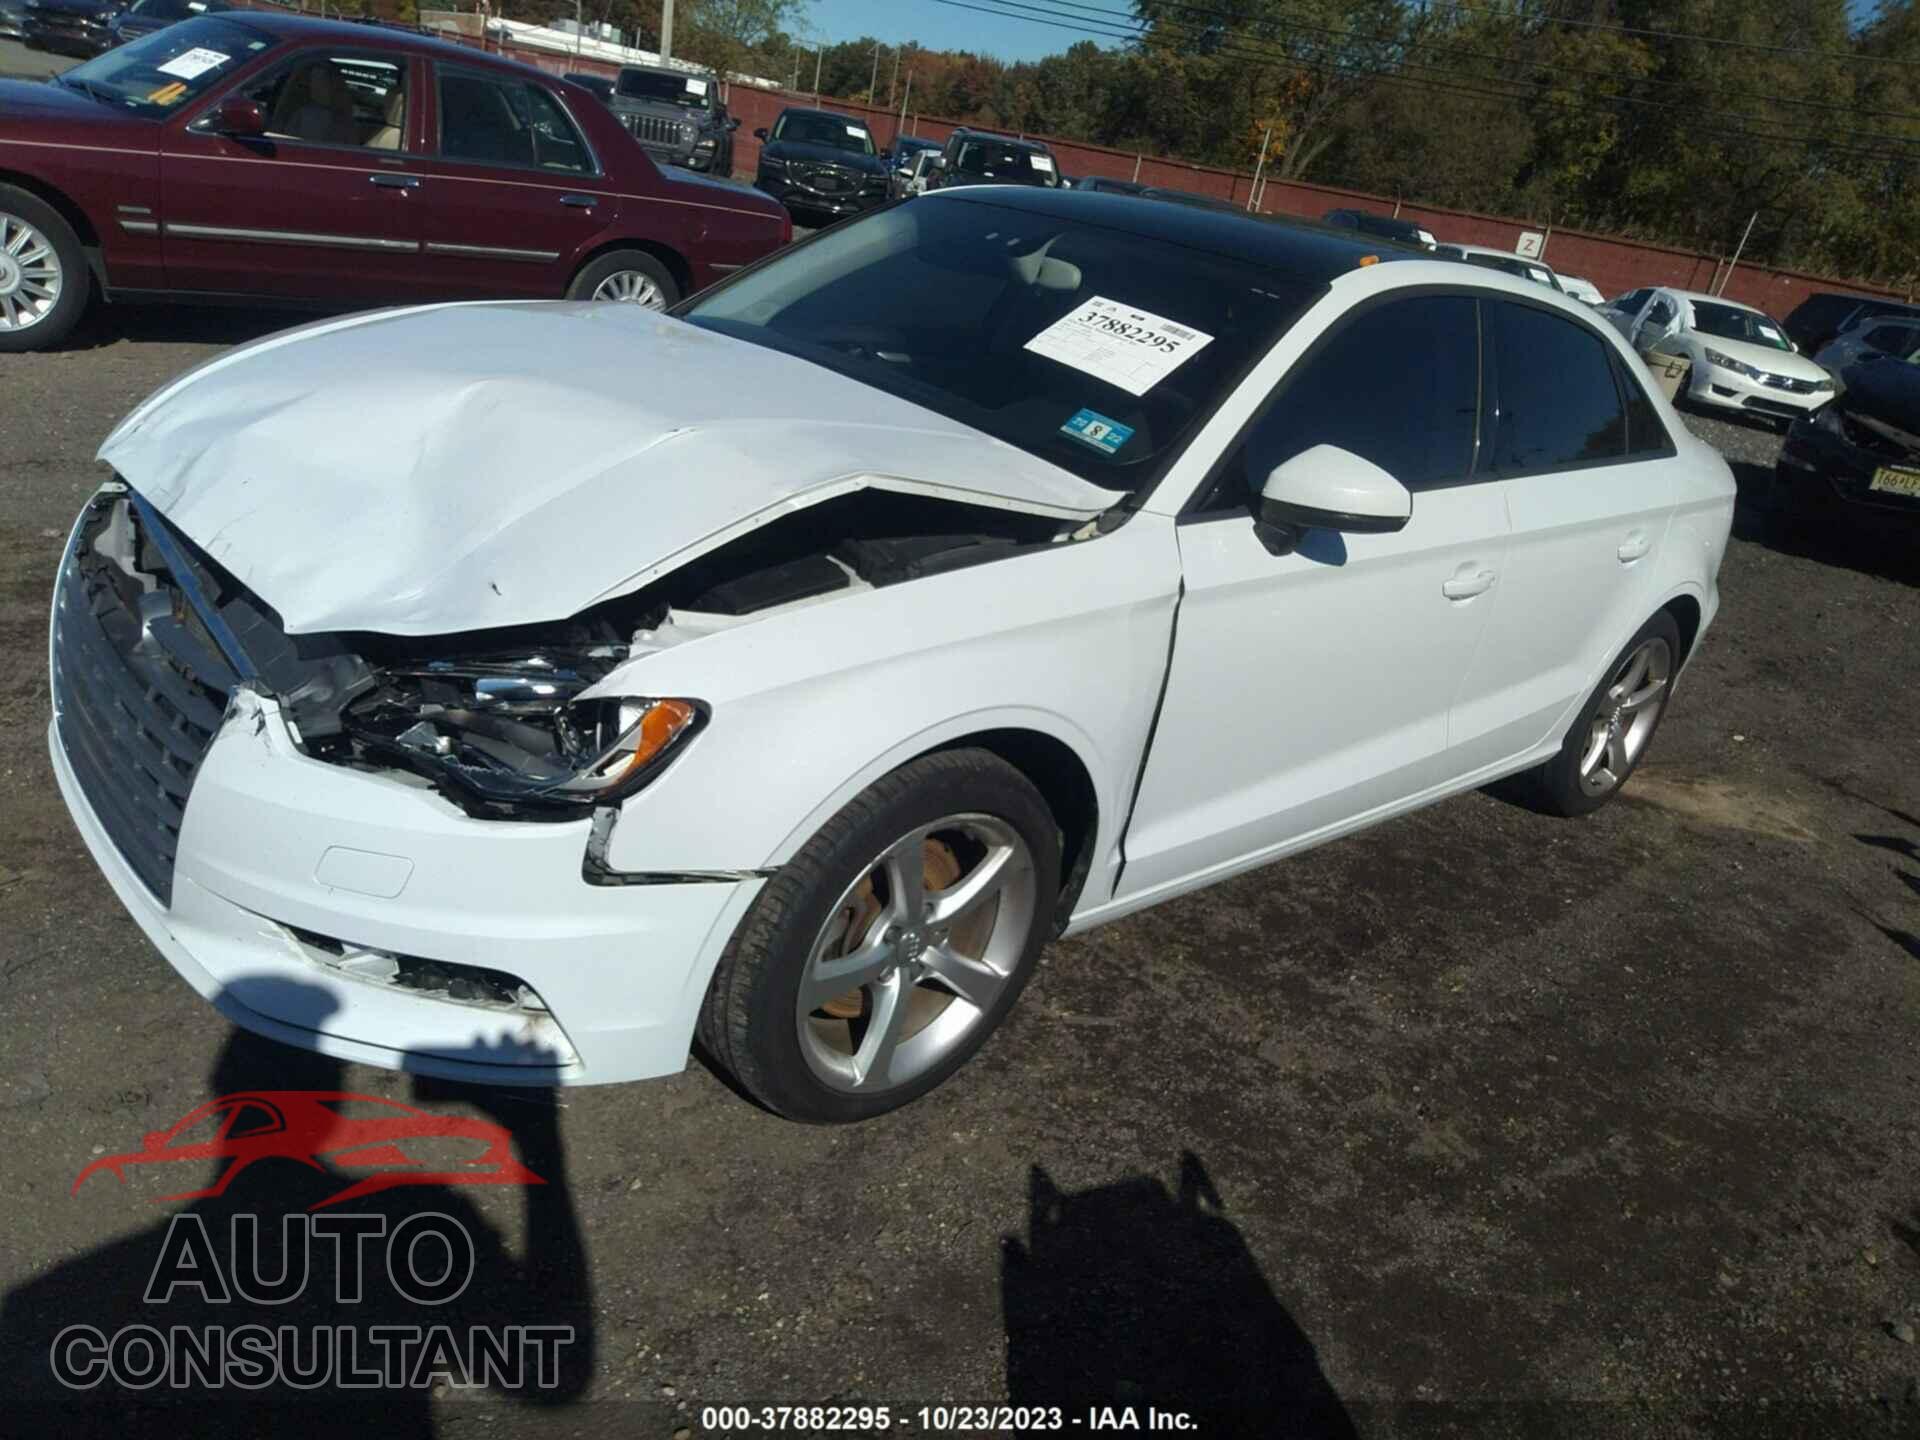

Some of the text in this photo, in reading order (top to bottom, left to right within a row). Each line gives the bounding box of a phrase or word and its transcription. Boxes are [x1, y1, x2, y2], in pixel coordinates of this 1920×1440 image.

[1523, 239, 1535, 251] Z
[1078, 311, 1181, 353] 37882295
[1090, 425, 1103, 436] 8
